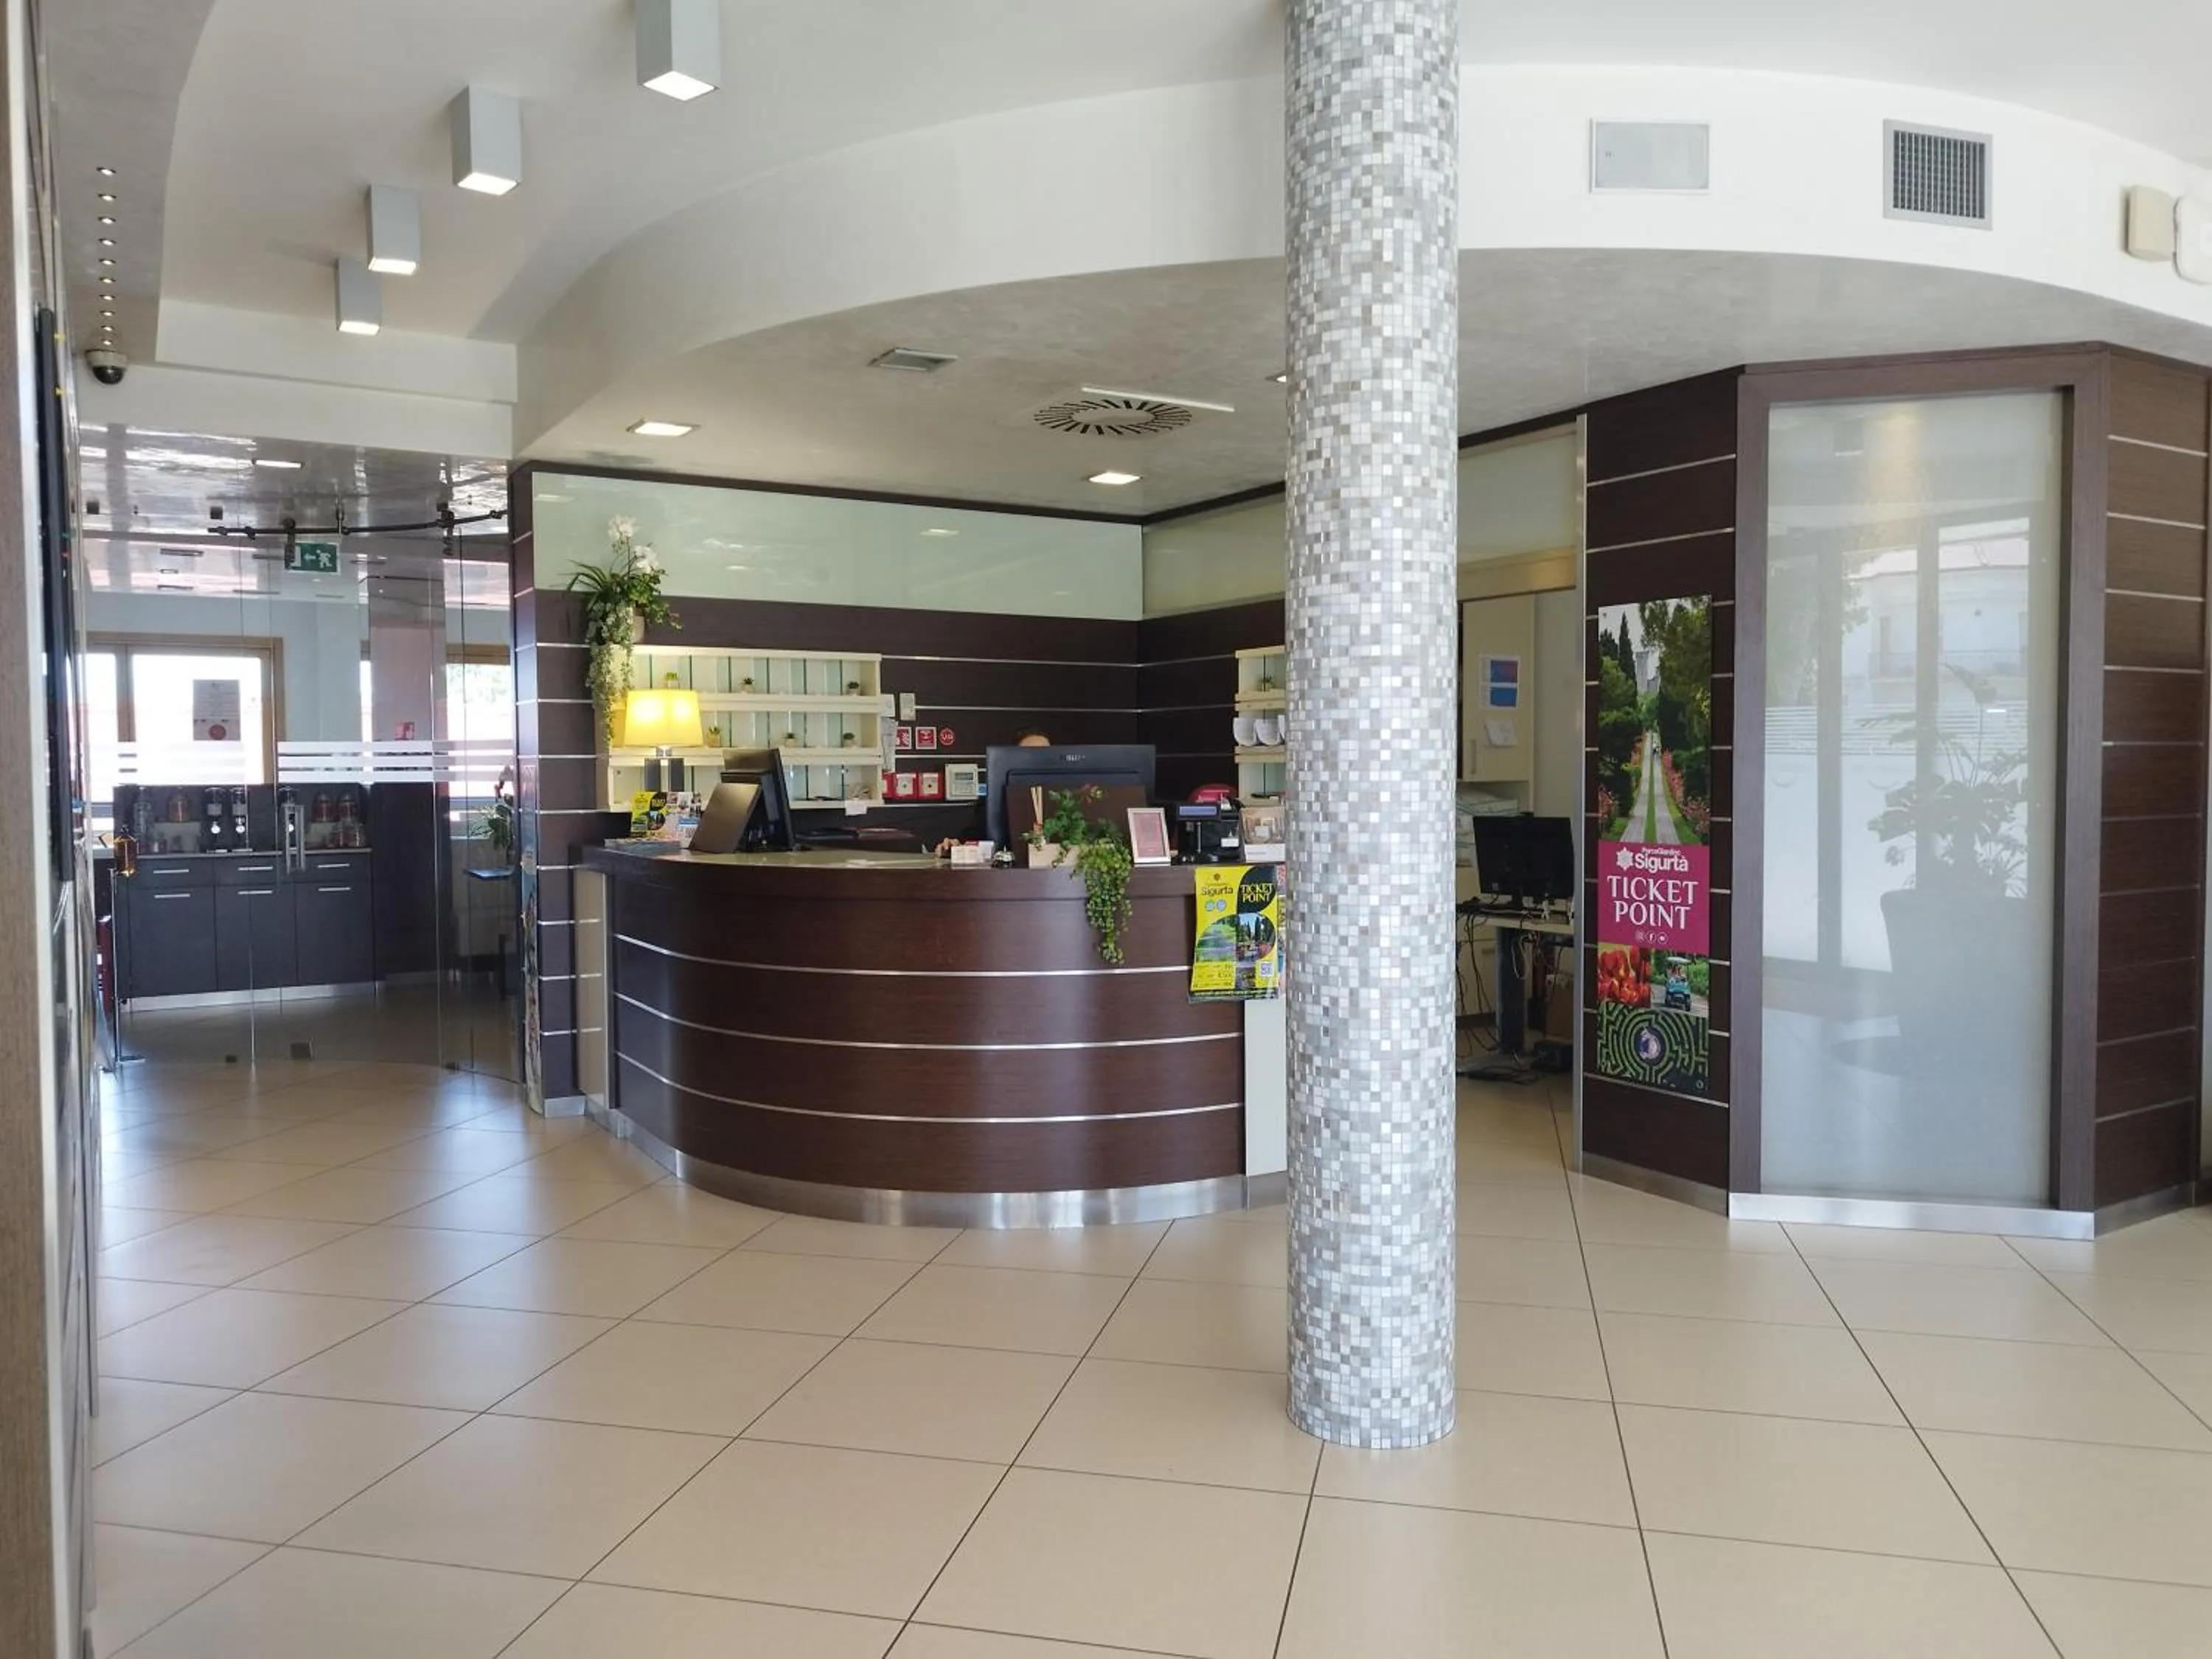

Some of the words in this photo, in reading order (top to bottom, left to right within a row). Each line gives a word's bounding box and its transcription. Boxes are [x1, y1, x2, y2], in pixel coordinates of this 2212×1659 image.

[1242, 892, 1270, 902] POINT
[1607, 875, 1699, 904] TICKET
[1614, 900, 1691, 930] POINT
